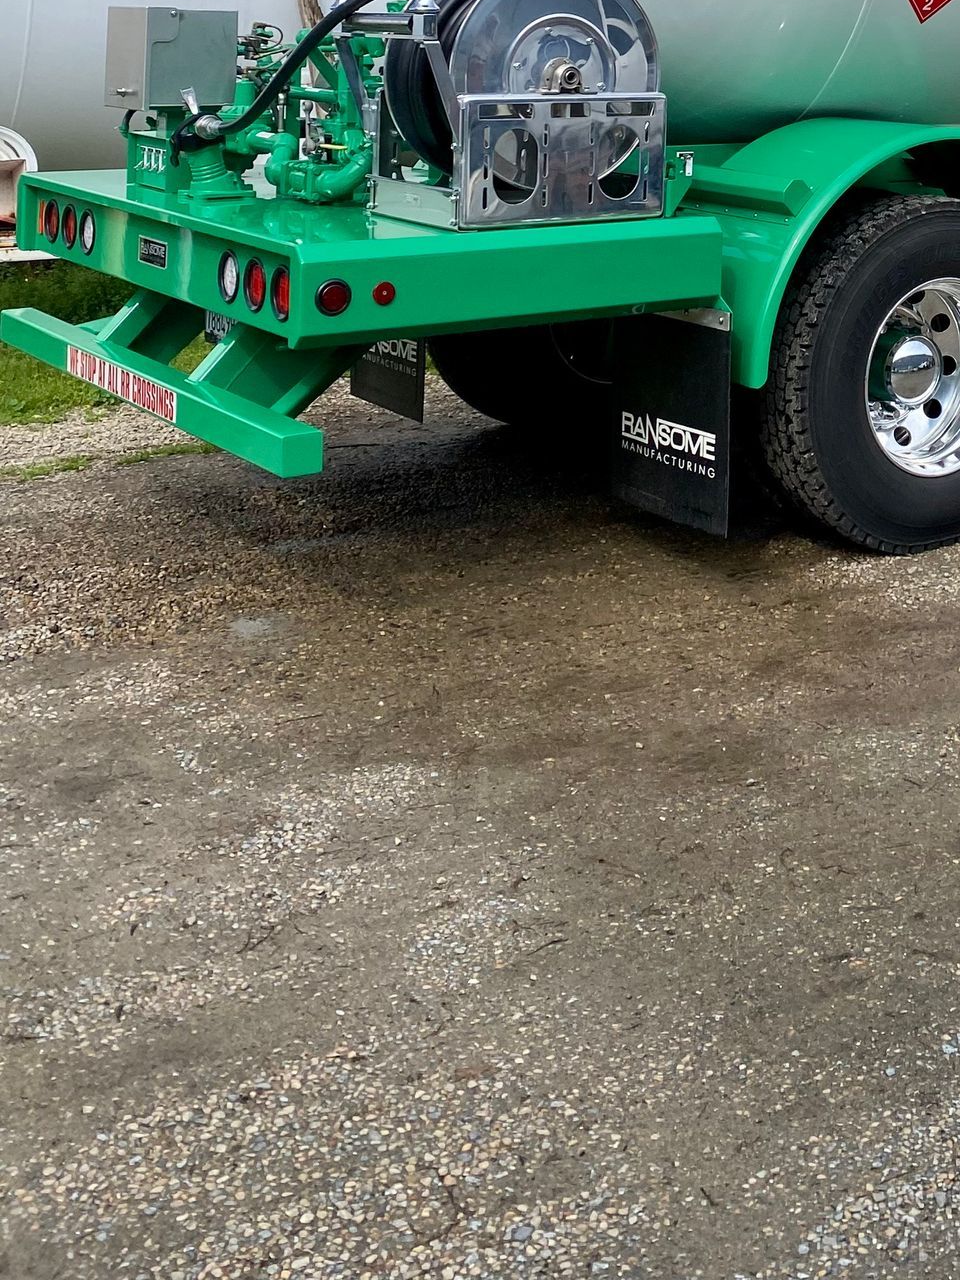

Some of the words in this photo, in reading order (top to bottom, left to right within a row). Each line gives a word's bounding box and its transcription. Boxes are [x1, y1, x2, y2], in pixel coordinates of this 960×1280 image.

[69, 345, 79, 376] WE
[80, 351, 97, 383] STOP
[98, 359, 106, 389] AT
[107, 363, 119, 395] ALL
[120, 369, 130, 400] RR
[132, 374, 175, 421] CROSSINGS
[361, 353, 417, 377] ANUFACTURING
[621, 410, 717, 461] RANSOME
[621, 439, 716, 479] MANUFACTURING
